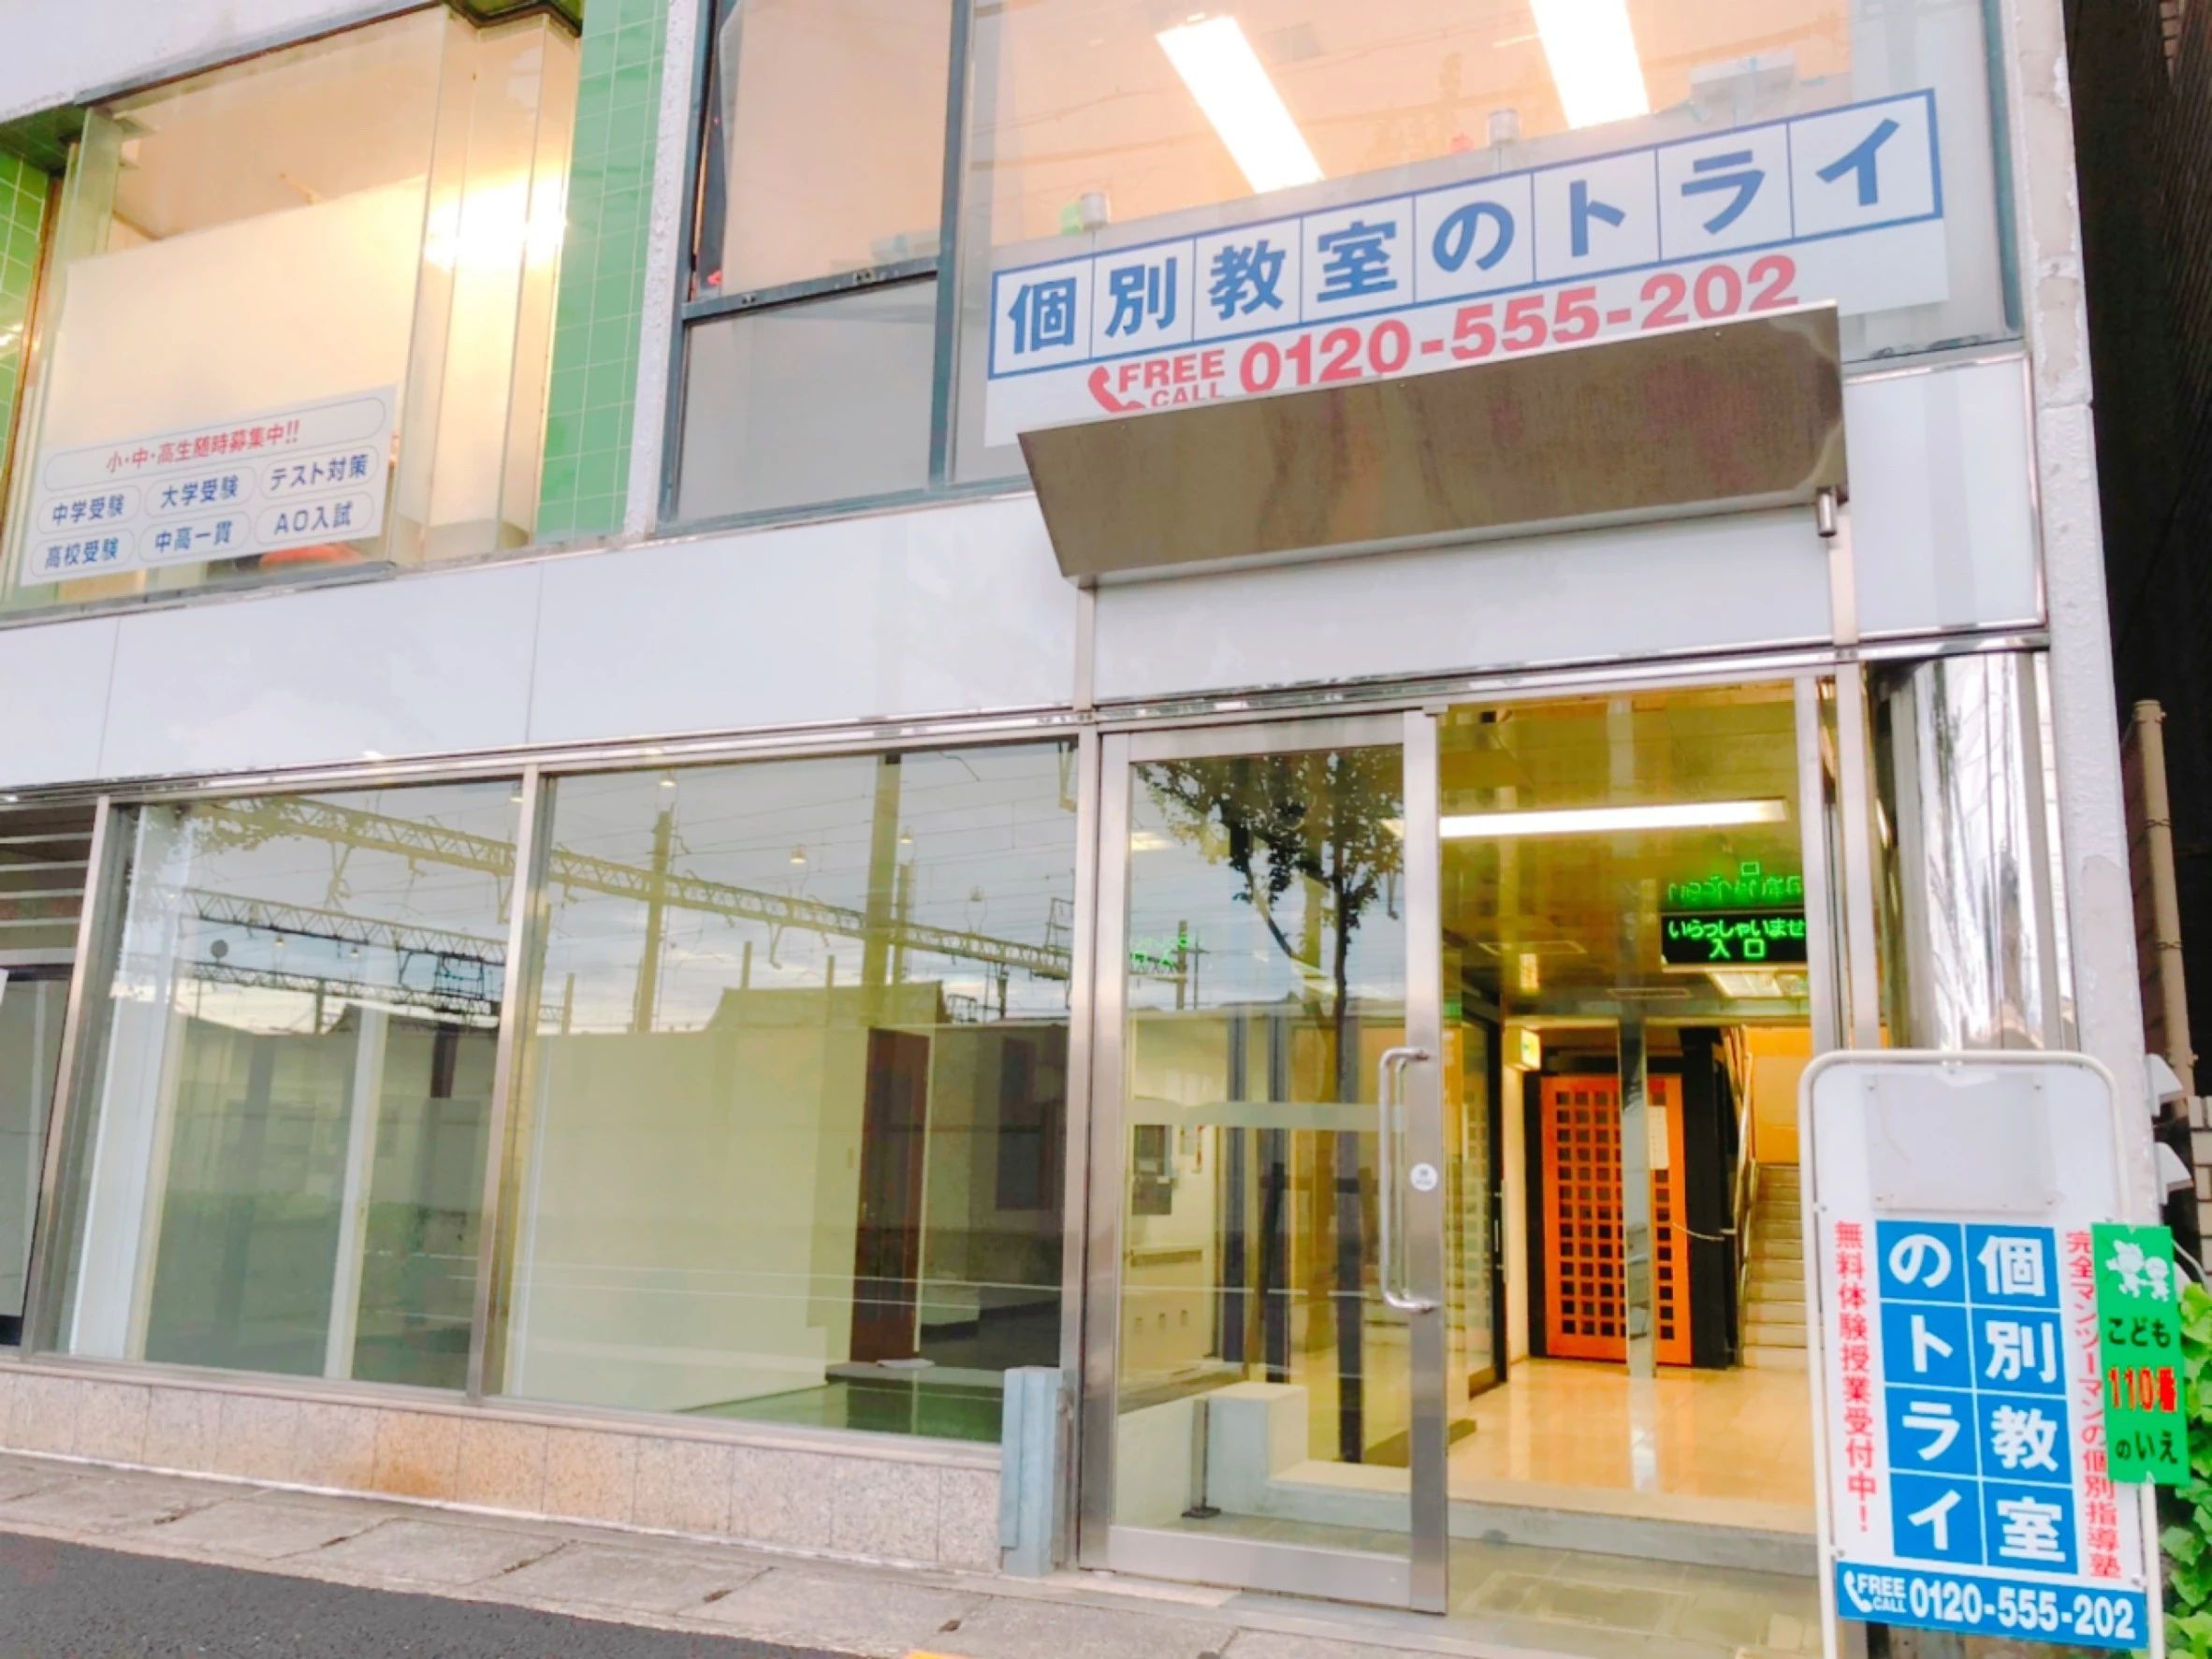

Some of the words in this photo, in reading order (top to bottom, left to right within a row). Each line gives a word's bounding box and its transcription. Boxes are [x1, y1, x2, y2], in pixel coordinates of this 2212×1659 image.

[1008, 118, 1900, 354] 個別教室のトライ
[1240, 254, 1800, 394] 0120-555-202
[1118, 348, 1226, 393] FREE
[1151, 382, 1225, 408] CALL
[52, 493, 125, 526] 中学受験
[160, 475, 240, 509] 大学受験
[269, 454, 370, 491] テスト対策
[44, 537, 120, 569] 高校受験
[154, 520, 233, 554] 中高一貫
[273, 502, 354, 535] AO入試
[1709, 938, 1766, 959] 入口
[2108, 1317, 2171, 1348] こども
[1888, 1233, 1962, 1551] のトライ
[1976, 1234, 2066, 1563] 個別教室
[2115, 1430, 2177, 1464] のいえ
[1856, 1573, 1905, 1596] FREE
[1871, 1596, 1906, 1614] CALL
[1909, 1578, 2135, 1639] 0120-555-202
